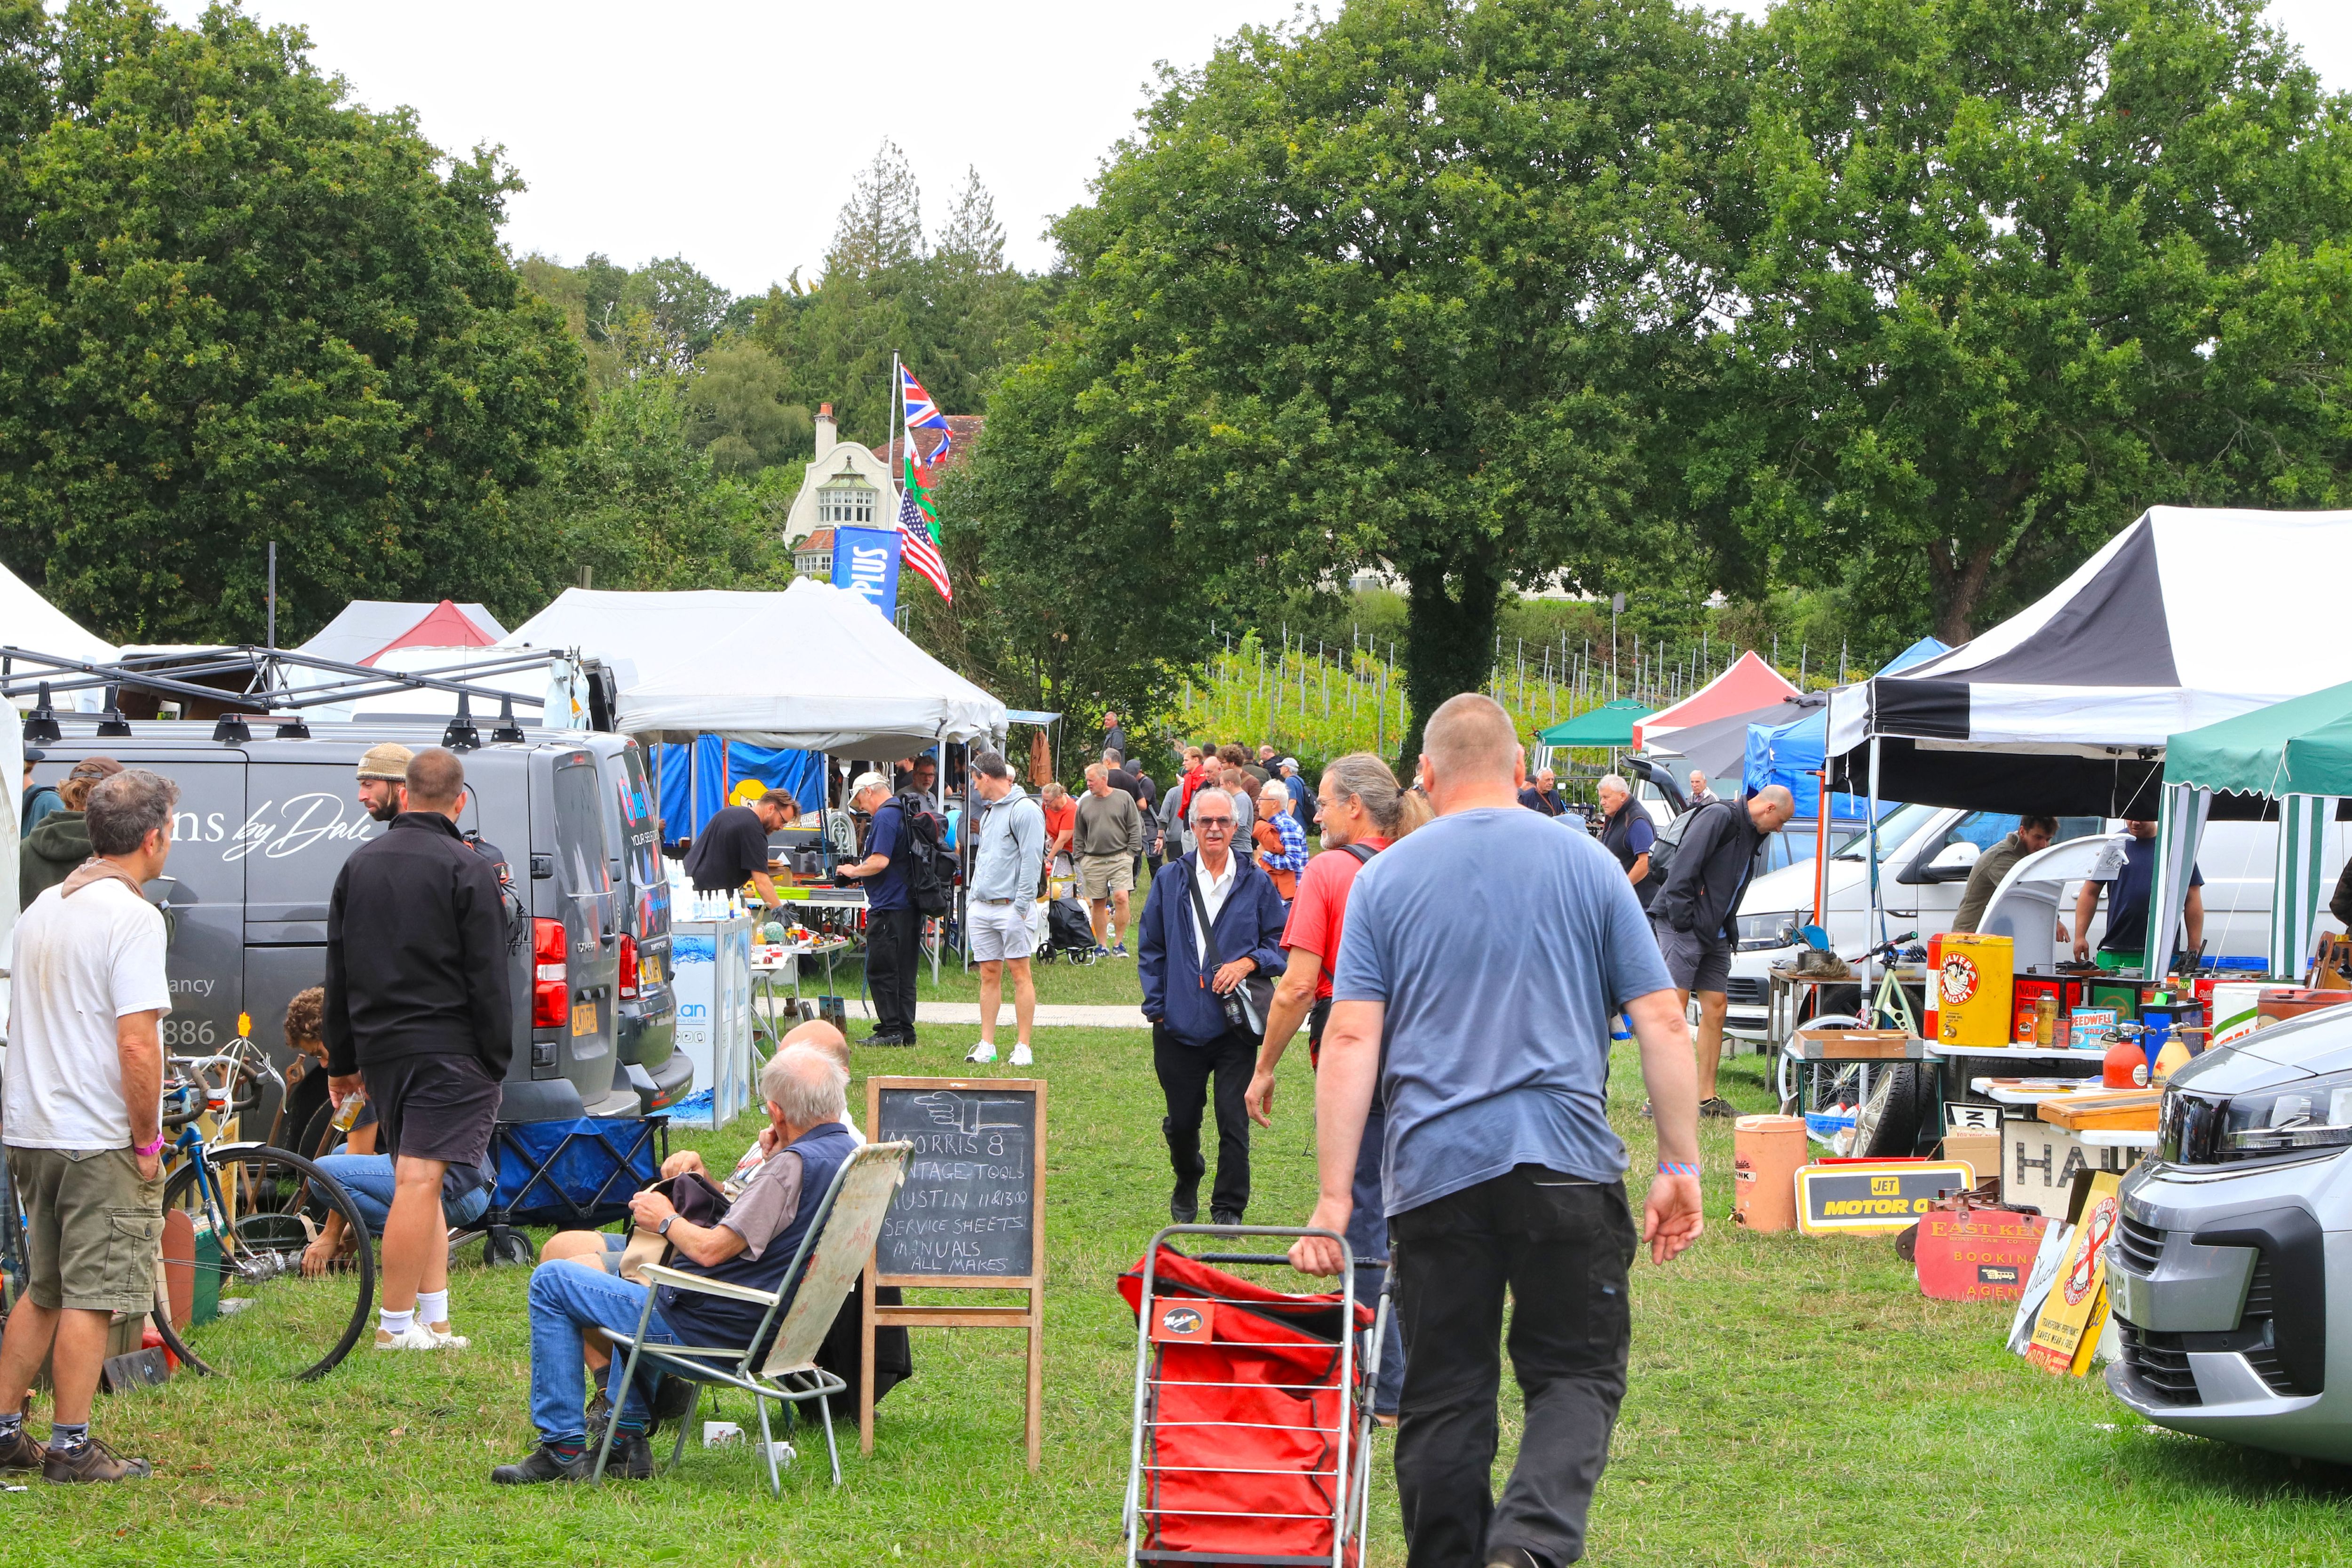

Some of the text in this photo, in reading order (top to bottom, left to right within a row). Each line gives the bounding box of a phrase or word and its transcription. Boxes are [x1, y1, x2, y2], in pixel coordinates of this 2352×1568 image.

[851, 546, 888, 596] PLUS
[222, 800, 276, 861] by
[265, 793, 375, 858] Dale
[630, 833, 645, 846] YOUR
[577, 942, 596, 953] EXPERT
[1942, 954, 1972, 970] SILVER
[168, 979, 215, 997] ancy
[1941, 985, 1973, 1003] KNIGHT
[677, 1004, 706, 1017] an
[163, 1020, 215, 1045] 886
[987, 1133, 1003, 1156] 8
[974, 1163, 1025, 1180] TOOLS
[1873, 1180, 1896, 1192] JET
[1824, 1199, 1909, 1215] MOTOR
[2095, 1199, 2117, 1221] REDEX
[885, 1216, 1024, 1236] SERVICE SHEETS
[1931, 1221, 1992, 1237] EAST
[893, 1240, 981, 1258] MANUALS
[911, 1256, 1009, 1272] ALL MAKES
[1967, 1285, 2025, 1297] AGEN
[2065, 1278, 2090, 1305] CONVERSION
[2042, 1318, 2062, 1331] TRANSFORMS
[2036, 1329, 2051, 1342] SAVES
[2051, 1334, 2062, 1345] WEAR
[2064, 1338, 2074, 1350] FUEL
